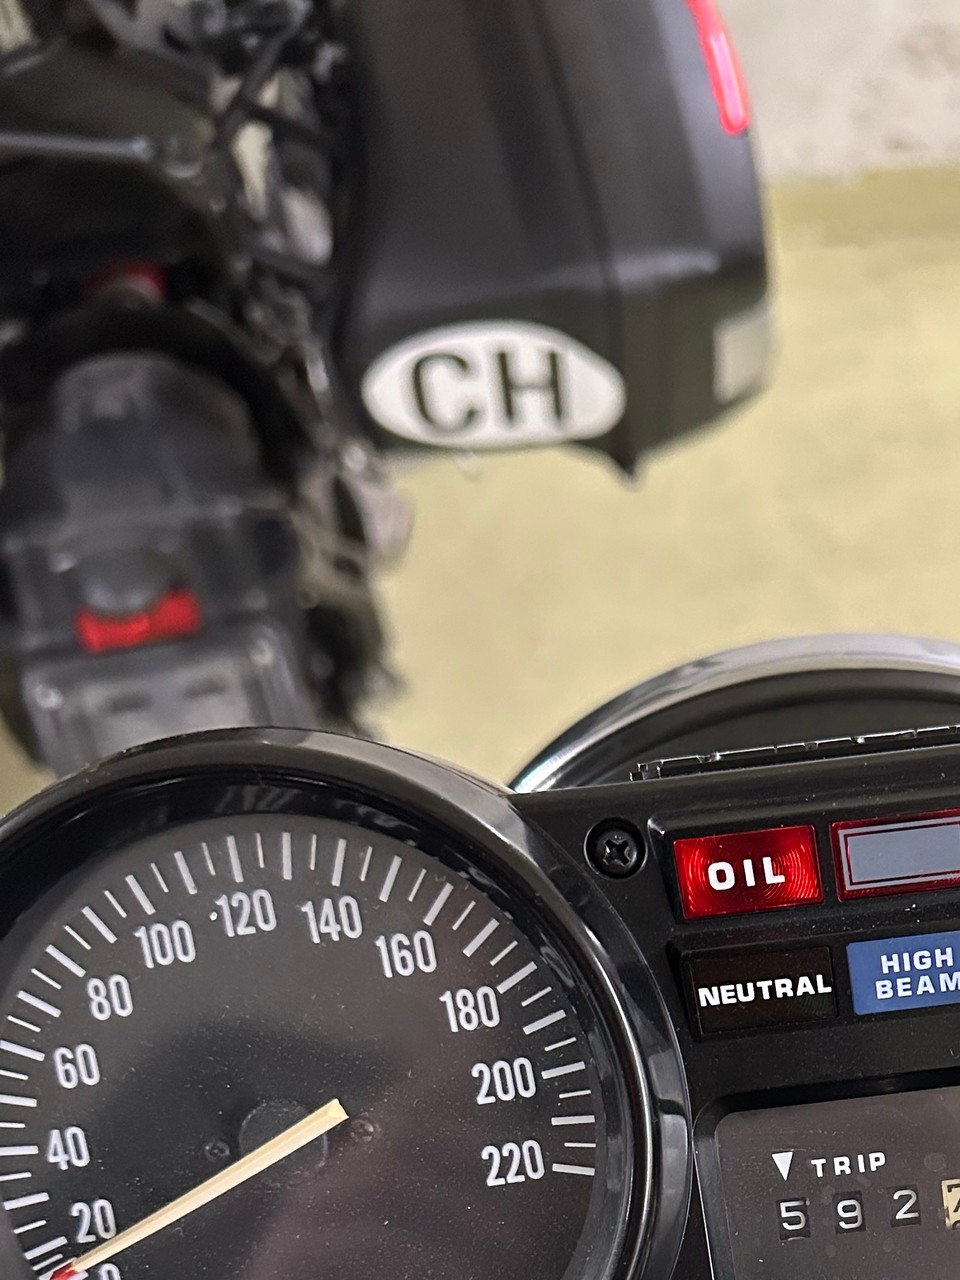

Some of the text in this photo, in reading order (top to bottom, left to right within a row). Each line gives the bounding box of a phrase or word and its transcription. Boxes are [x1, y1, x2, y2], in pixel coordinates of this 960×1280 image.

[411, 350, 563, 432] CH
[706, 856, 787, 892] OIL
[217, 889, 277, 937] 120
[301, 895, 363, 944] 140
[134, 920, 196, 969] 100
[374, 931, 437, 979] 160
[880, 946, 956, 975] HIGH
[86, 974, 134, 1021] 80
[439, 985, 501, 1033] 180
[697, 974, 833, 1008] NEUTRAL
[53, 1044, 101, 1089] 60
[471, 1057, 536, 1105] 200
[46, 1126, 91, 1170] 40
[480, 1140, 545, 1187] 220
[810, 1151, 887, 1178] TRIP
[71, 1199, 117, 1243] 20
